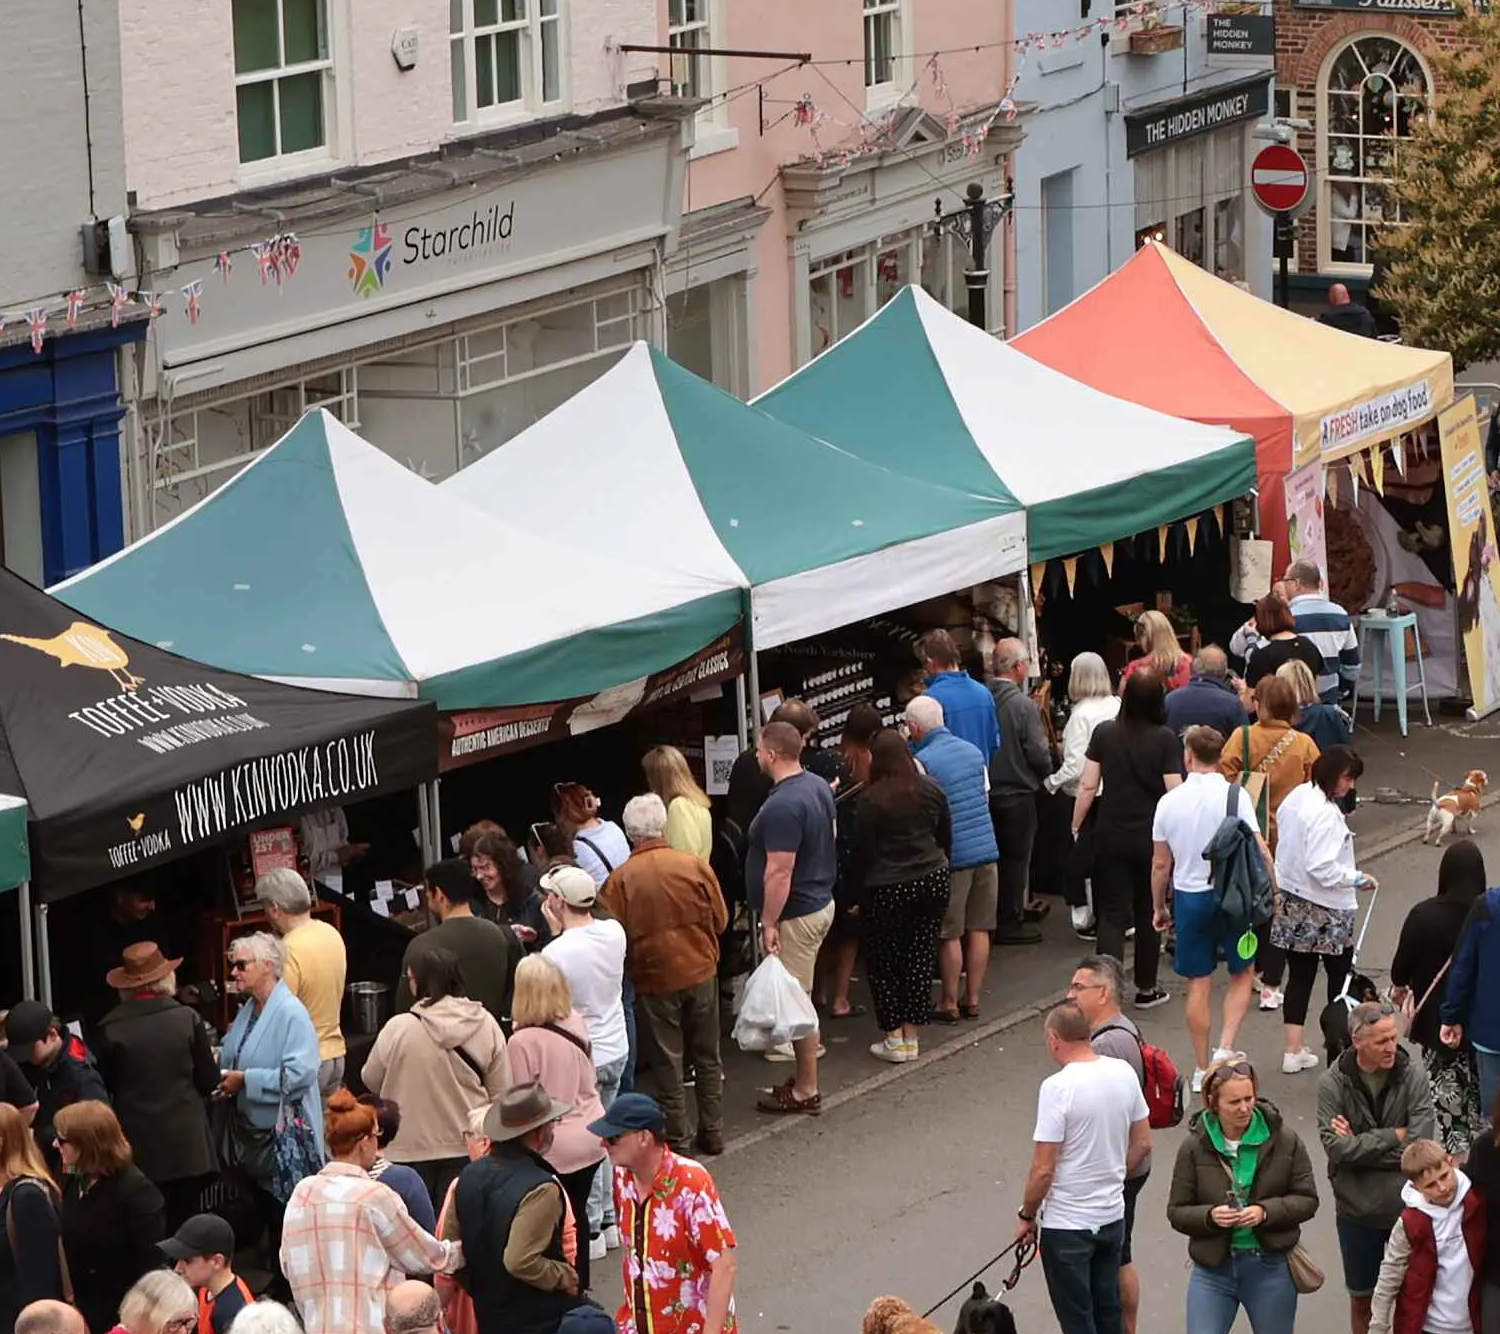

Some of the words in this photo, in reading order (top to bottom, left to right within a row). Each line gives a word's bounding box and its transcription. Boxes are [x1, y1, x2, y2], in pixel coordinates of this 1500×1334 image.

[1213, 19, 1231, 27] THE
[1213, 30, 1248, 38] HIDDEN
[1213, 41, 1252, 49] MONKEY
[1146, 120, 1165, 143] THE
[1168, 109, 1205, 137] HIDDEN
[1207, 94, 1249, 124] MONKEY
[403, 200, 514, 264] Starchild
[1322, 421, 1328, 445] A
[1330, 411, 1359, 441] FRESH
[1360, 404, 1379, 430] take
[1380, 404, 1391, 423] on
[1392, 395, 1408, 419] dog
[1408, 383, 1428, 412] food
[699, 649, 729, 681] CLASSICS
[451, 734, 487, 758] AUTHENTIC
[487, 723, 518, 750] AMERICAN
[519, 716, 553, 742] DESSERTS
[174, 730, 379, 844] WWW.KINVODKA.CO.UK
